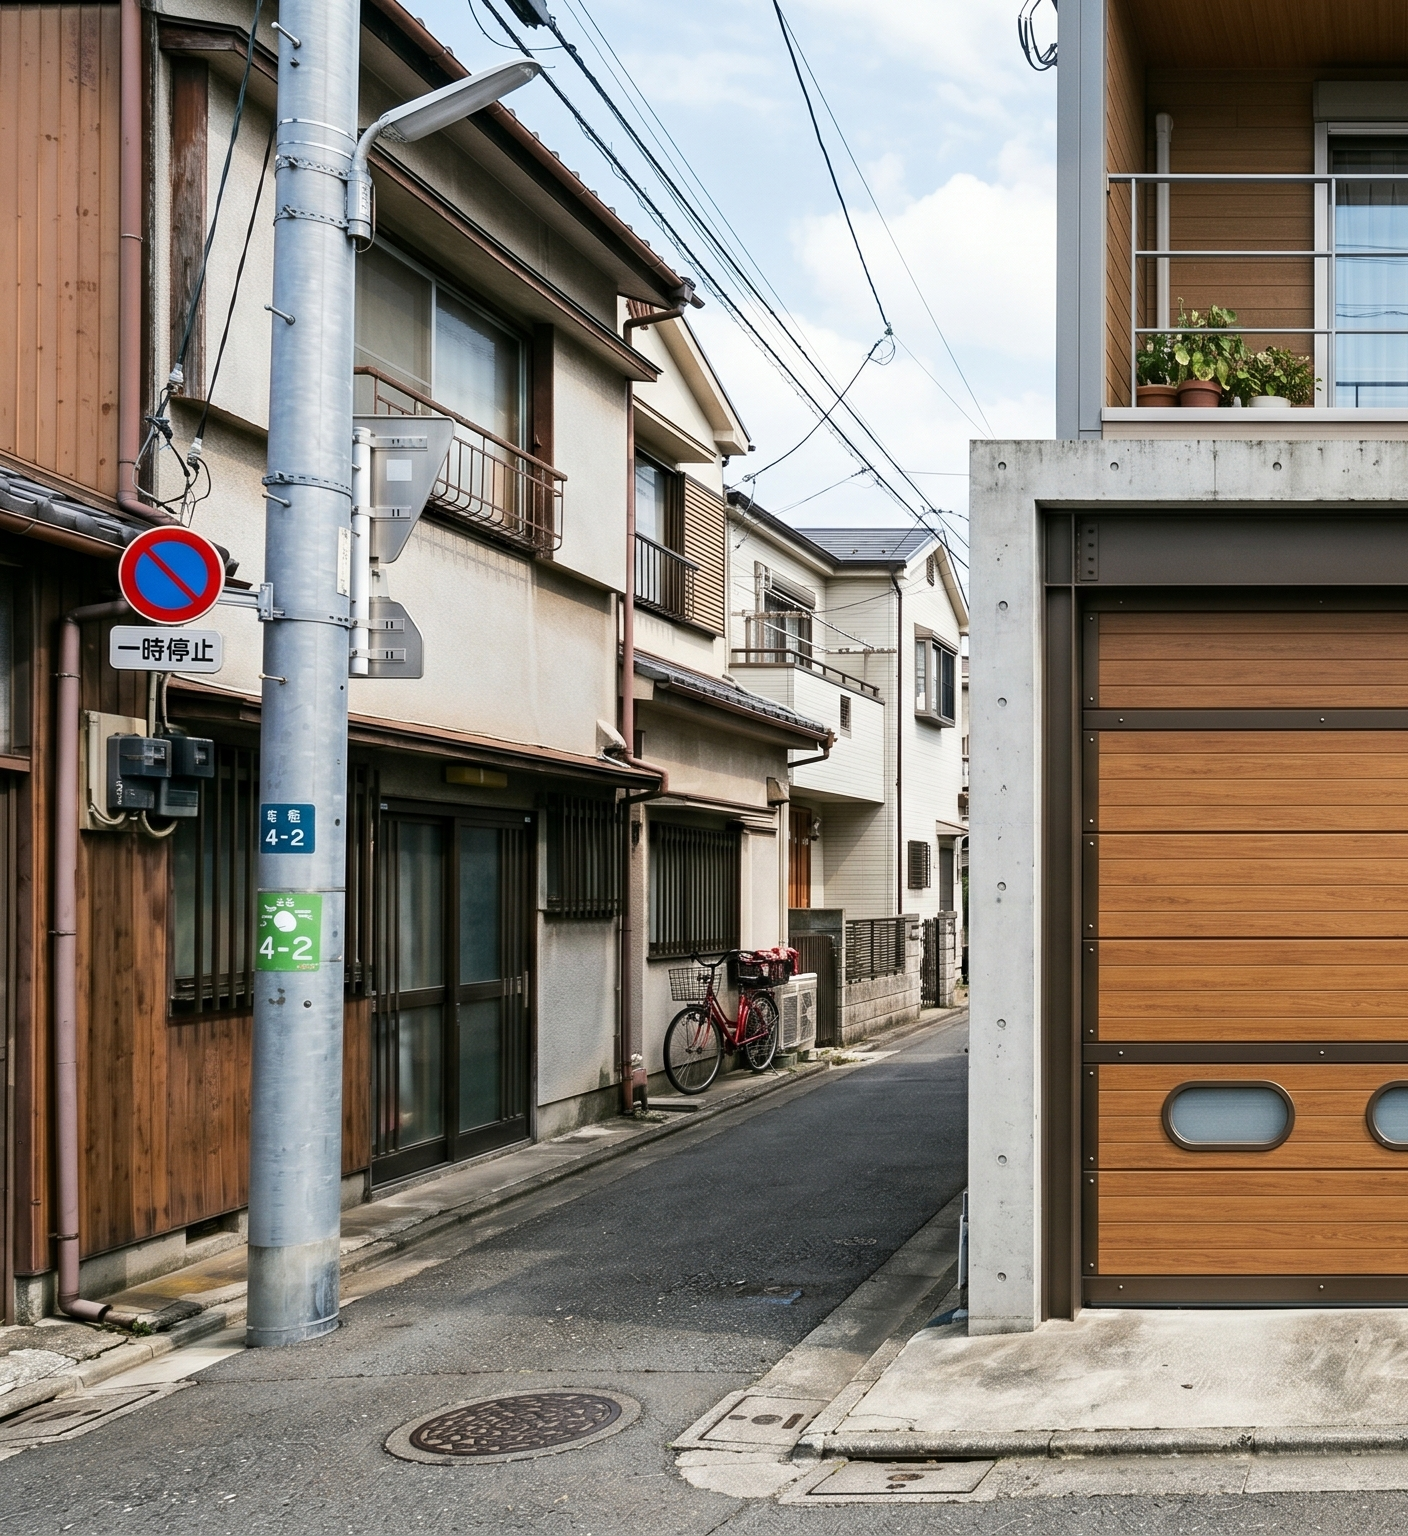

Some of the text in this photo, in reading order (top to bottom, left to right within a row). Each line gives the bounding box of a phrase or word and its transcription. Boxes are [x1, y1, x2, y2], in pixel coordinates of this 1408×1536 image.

[118, 637, 214, 662] 一時停止
[265, 828, 305, 846] 4-2
[259, 936, 313, 961] 4-2
